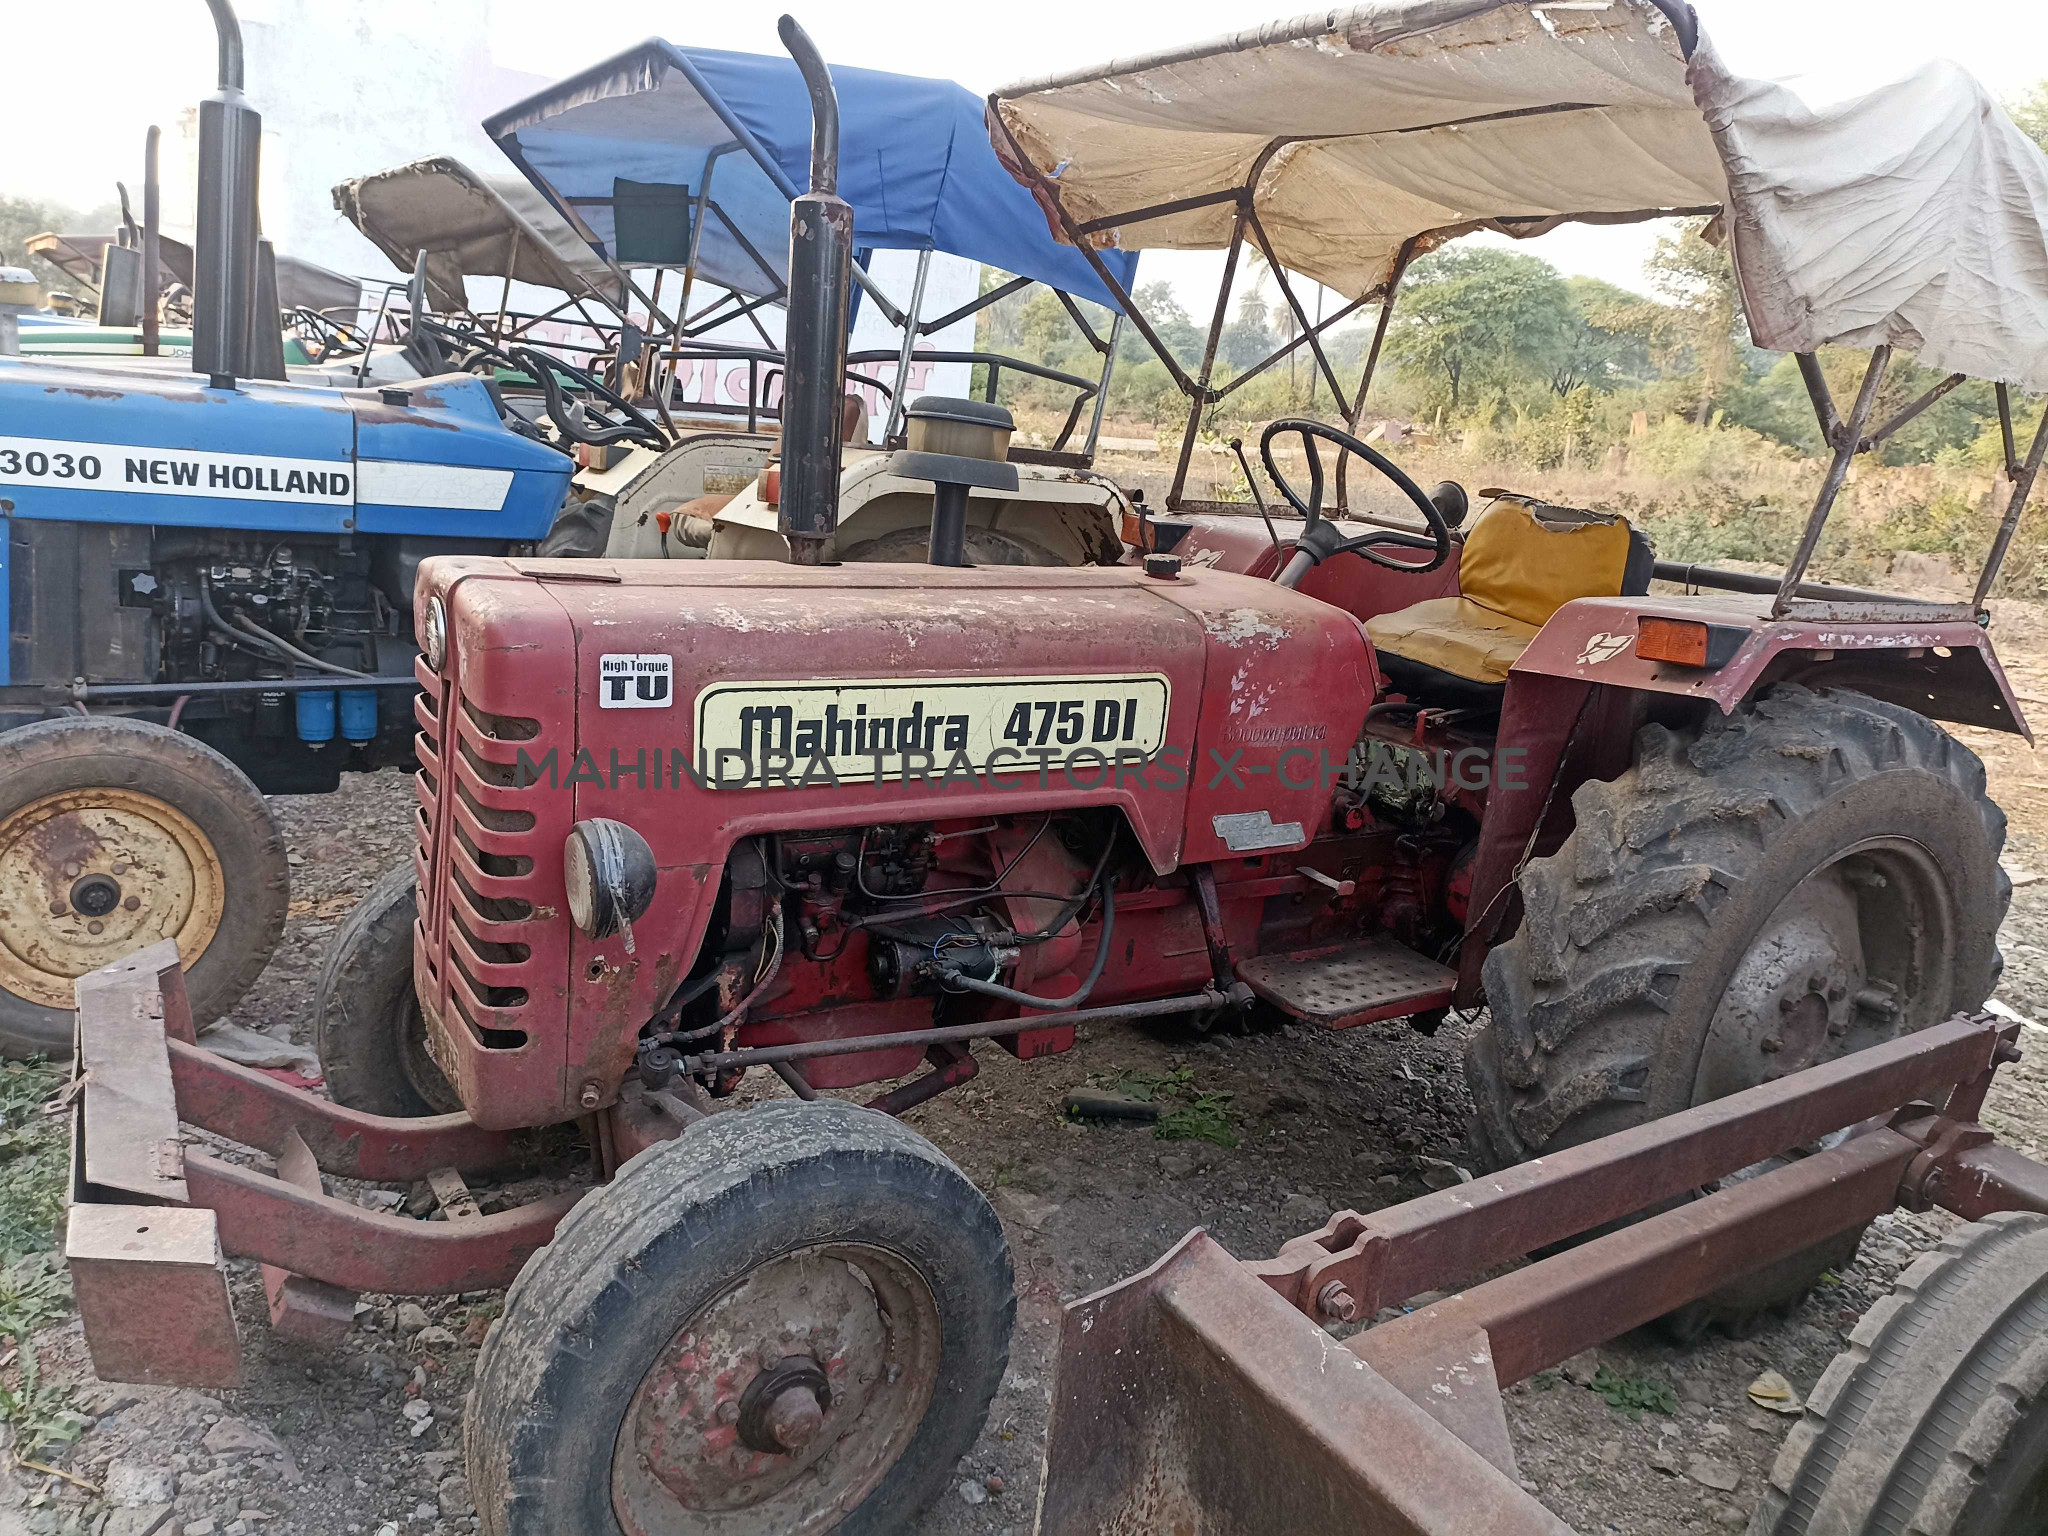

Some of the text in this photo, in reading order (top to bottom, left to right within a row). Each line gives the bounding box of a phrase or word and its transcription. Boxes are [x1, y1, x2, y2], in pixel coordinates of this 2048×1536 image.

[0, 449, 350, 496] 3030 NEW HOLLAND
[603, 660, 669, 673] High Torque
[603, 675, 669, 701] TU
[740, 698, 1138, 760] Mahindra 475 DI
